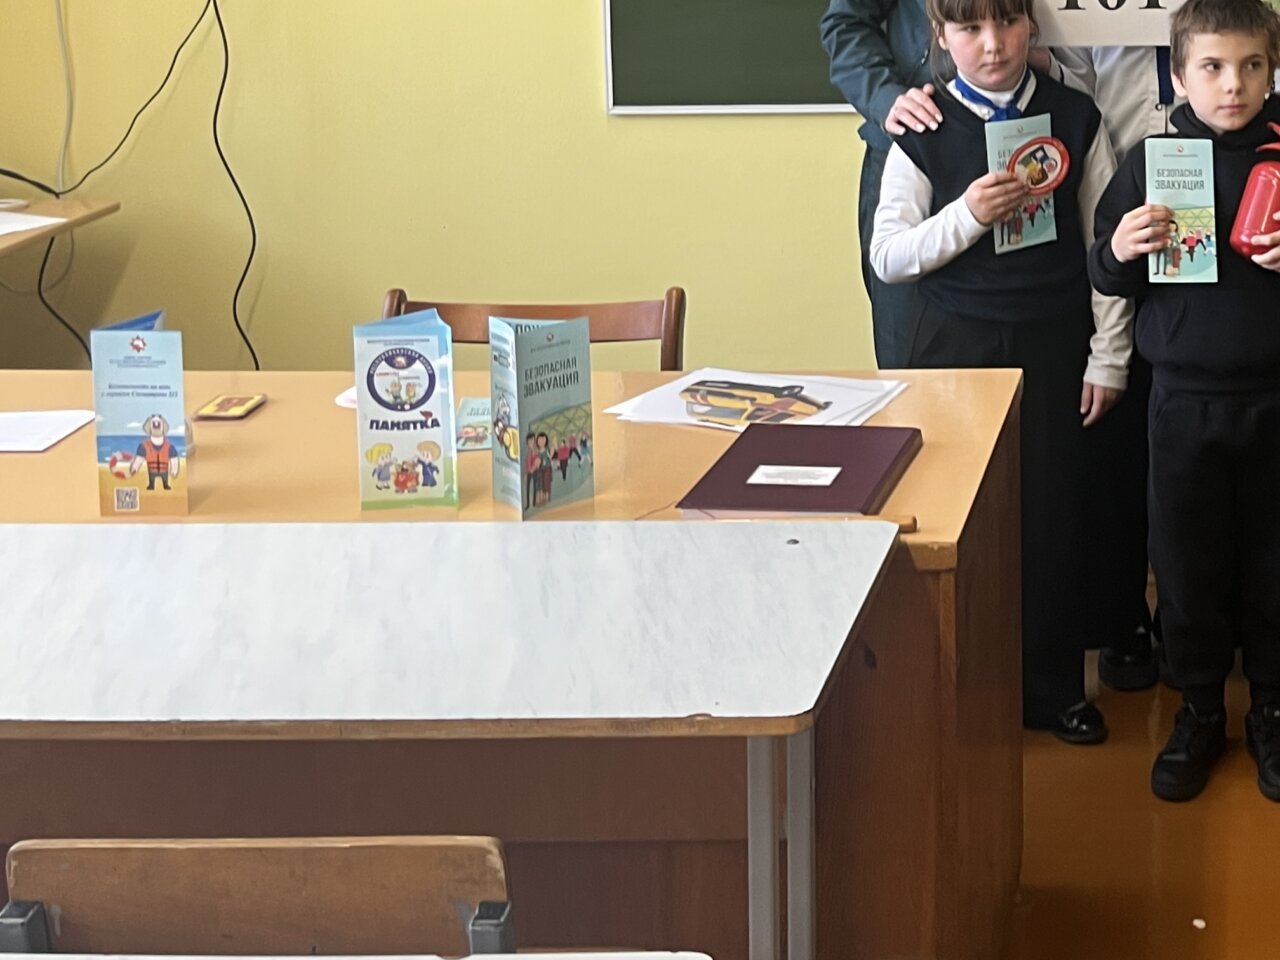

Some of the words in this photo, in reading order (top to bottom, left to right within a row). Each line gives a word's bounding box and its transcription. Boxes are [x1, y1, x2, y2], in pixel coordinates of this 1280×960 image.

[1156, 169, 1203, 179] БЕЗОПАСНАЯ
[1154, 180, 1204, 191] ЭВАКУАЦИЯ
[524, 356, 578, 381] БЕЗОПАСНАЯ
[523, 371, 580, 398] ЭВАКУАЦИЯ
[369, 417, 441, 431] ПАМЯТКА
